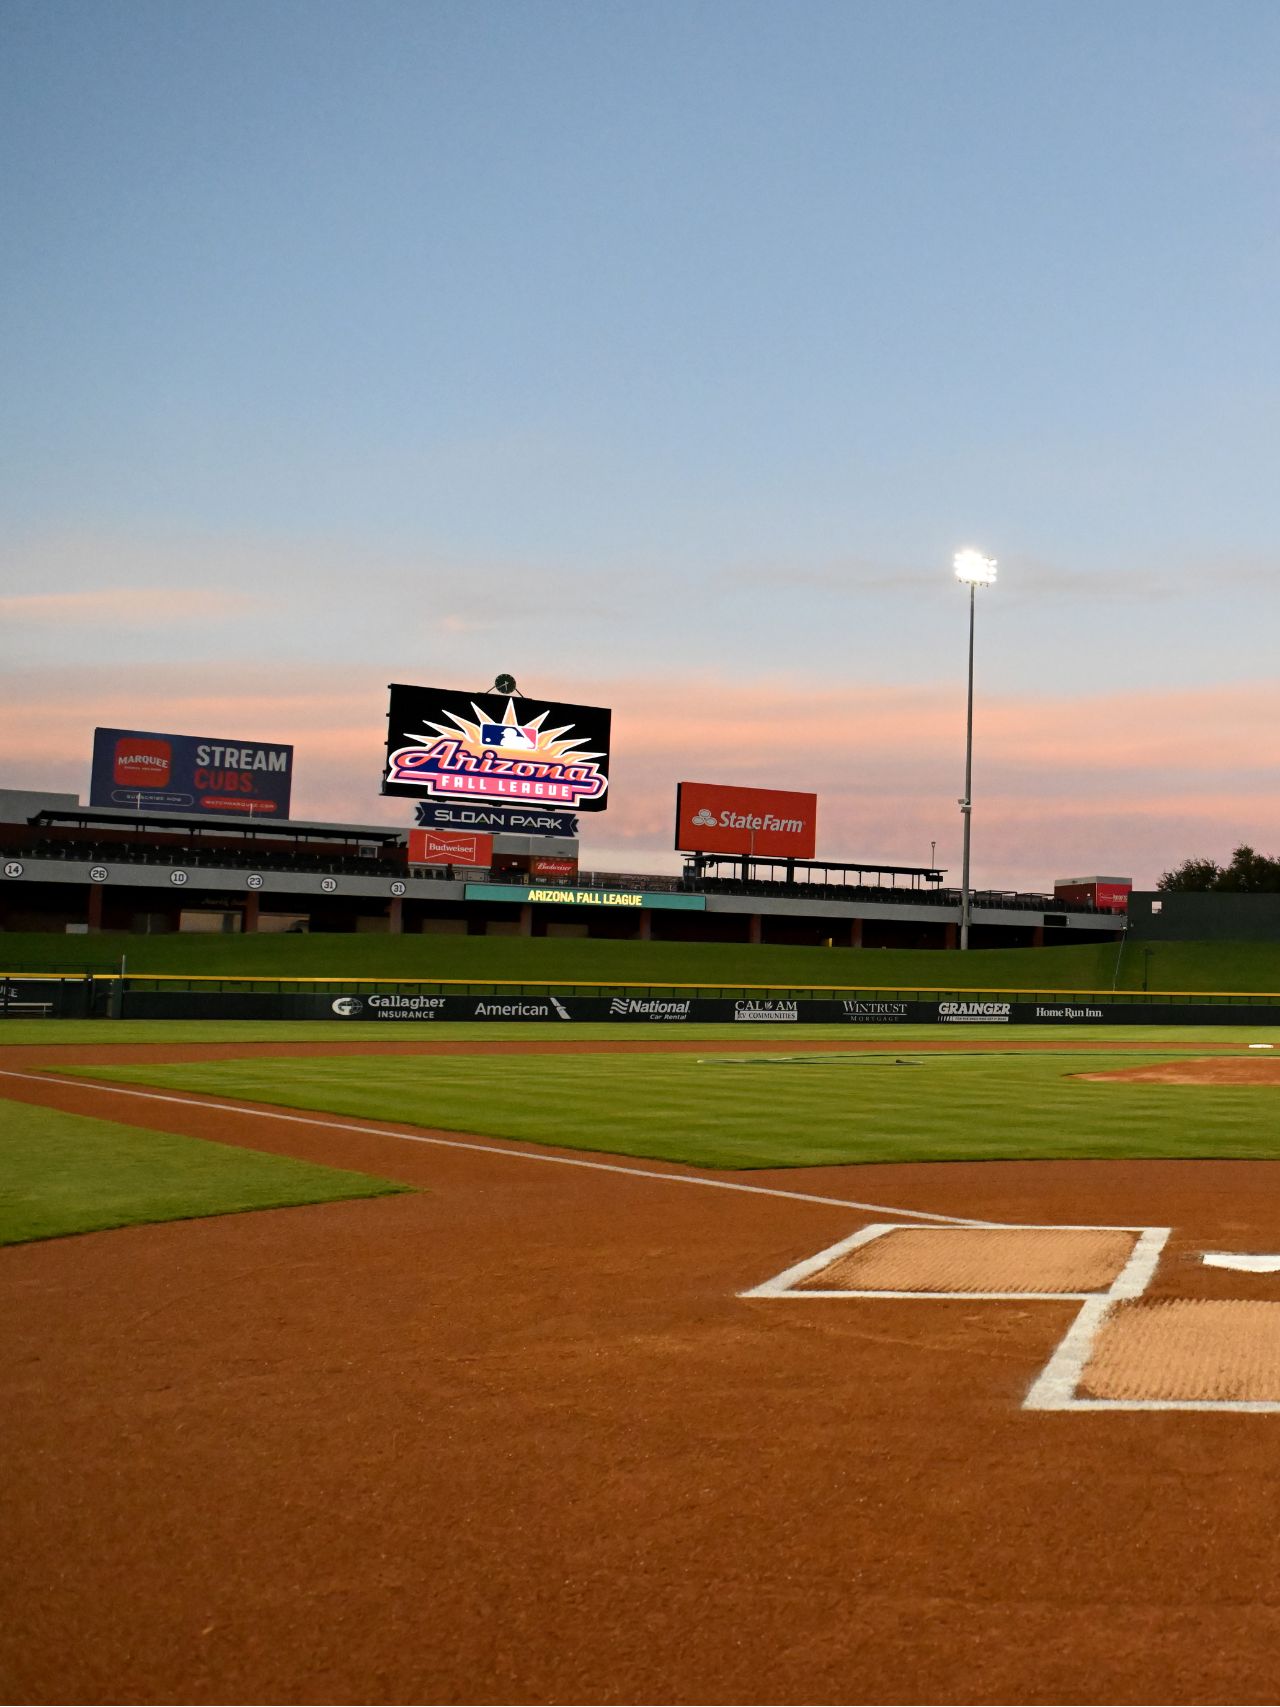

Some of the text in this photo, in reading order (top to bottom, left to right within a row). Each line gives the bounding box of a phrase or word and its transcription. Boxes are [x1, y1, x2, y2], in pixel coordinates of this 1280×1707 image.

[118, 755, 169, 769] MARQUEE
[195, 745, 287, 772] STREAM
[397, 740, 593, 781] Arizona
[441, 775, 569, 797] FALL LEAGUE
[434, 810, 562, 830] SLOAN PARK
[429, 843, 473, 853] Budweiser
[8, 865, 19, 874] 14
[536, 862, 572, 871] Budweiser
[93, 869, 105, 878] 26
[173, 873, 184, 882] 10
[250, 877, 261, 886] 23
[324, 881, 333, 889] 31
[394, 885, 403, 893] 31
[528, 890, 643, 906] ARIZONA FALL LEAGUE
[367, 995, 446, 1009] Gallagher
[629, 1000, 691, 1013] National
[735, 1000, 798, 1011] CAL AM
[843, 1001, 908, 1013] WINTRUST
[474, 1002, 548, 1016] American
[938, 1002, 1011, 1015] GRAINGER
[1036, 1007, 1064, 1017] Home
[1064, 1007, 1084, 1018] Run
[378, 1010, 435, 1019] INSURANCE
[749, 1012, 796, 1020] COMMUNITIES
